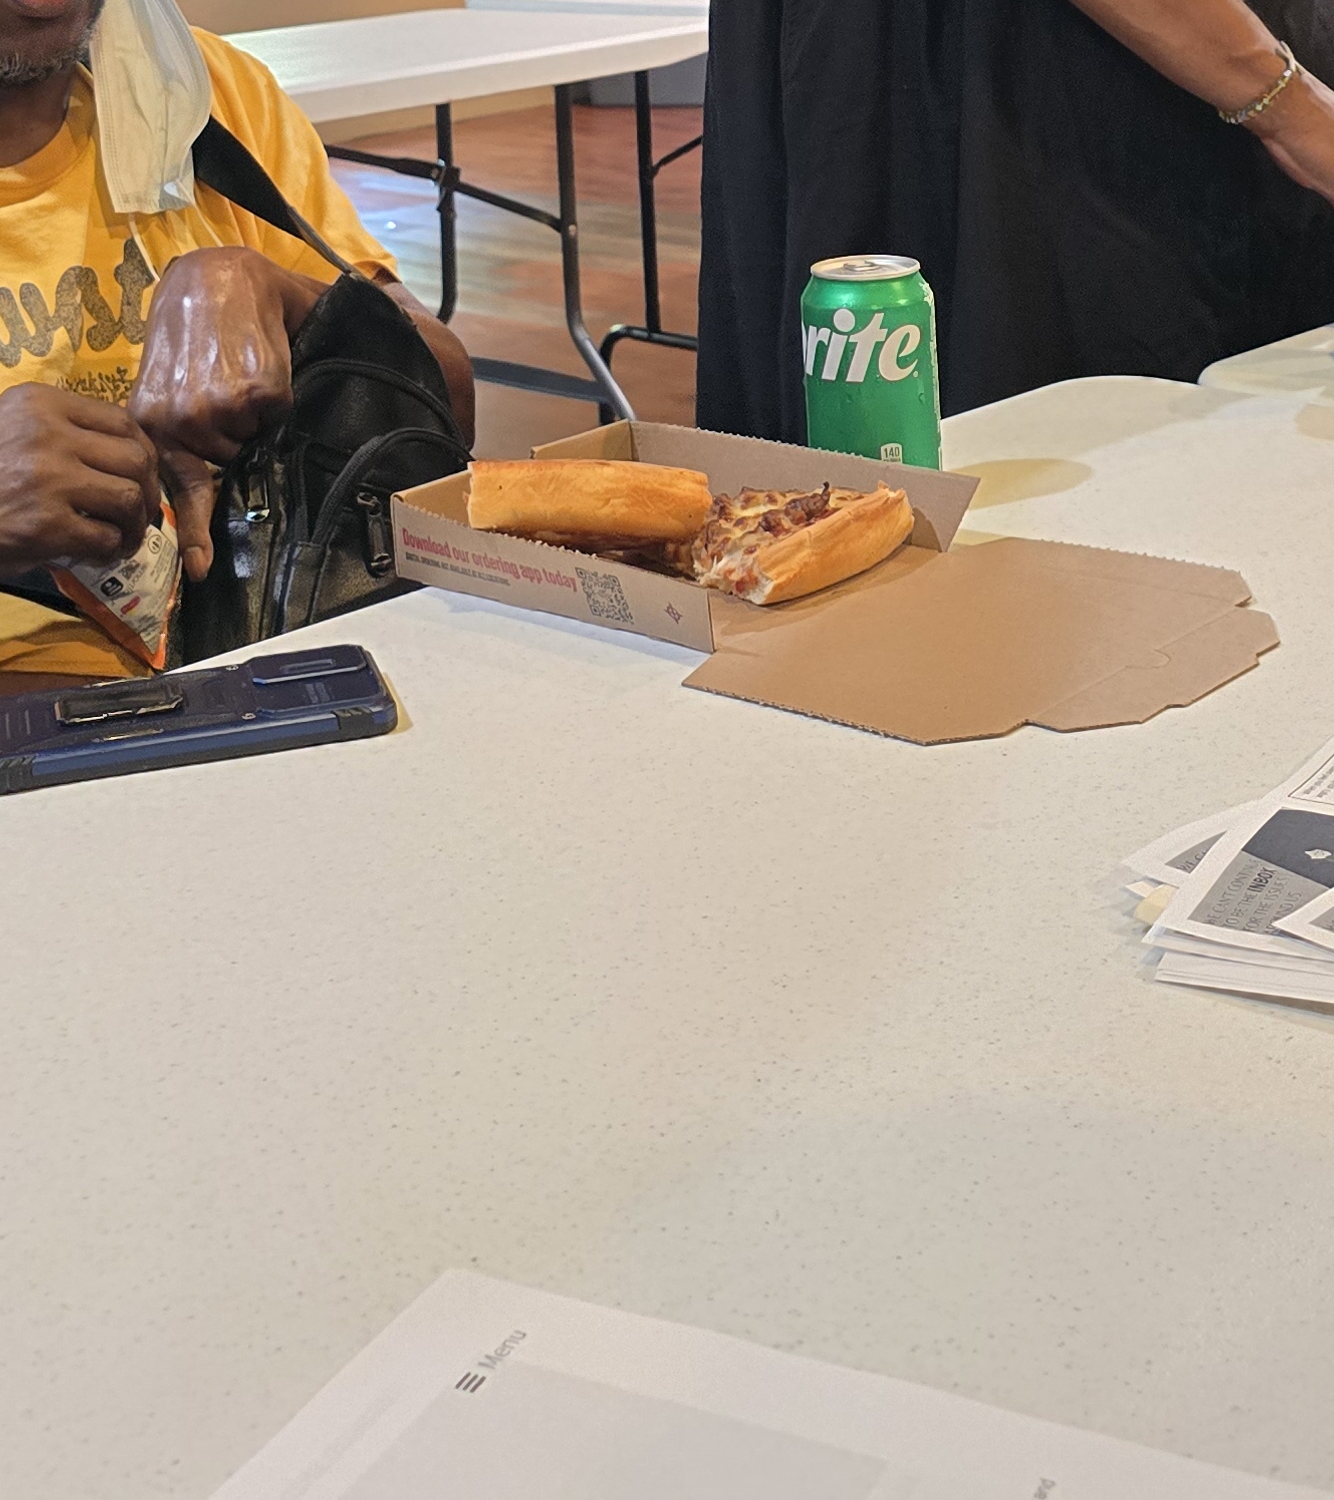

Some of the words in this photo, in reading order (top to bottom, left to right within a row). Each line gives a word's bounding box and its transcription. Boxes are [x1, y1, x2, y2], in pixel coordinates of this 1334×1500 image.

[802, 308, 921, 383] rite
[883, 446, 900, 459] 140
[401, 527, 452, 558] Download
[453, 546, 470, 563] our
[472, 552, 521, 580] ordering
[520, 564, 543, 584] app
[544, 566, 578, 592] today
[1247, 867, 1277, 893] INBOX
[477, 1329, 527, 1370] Menu
